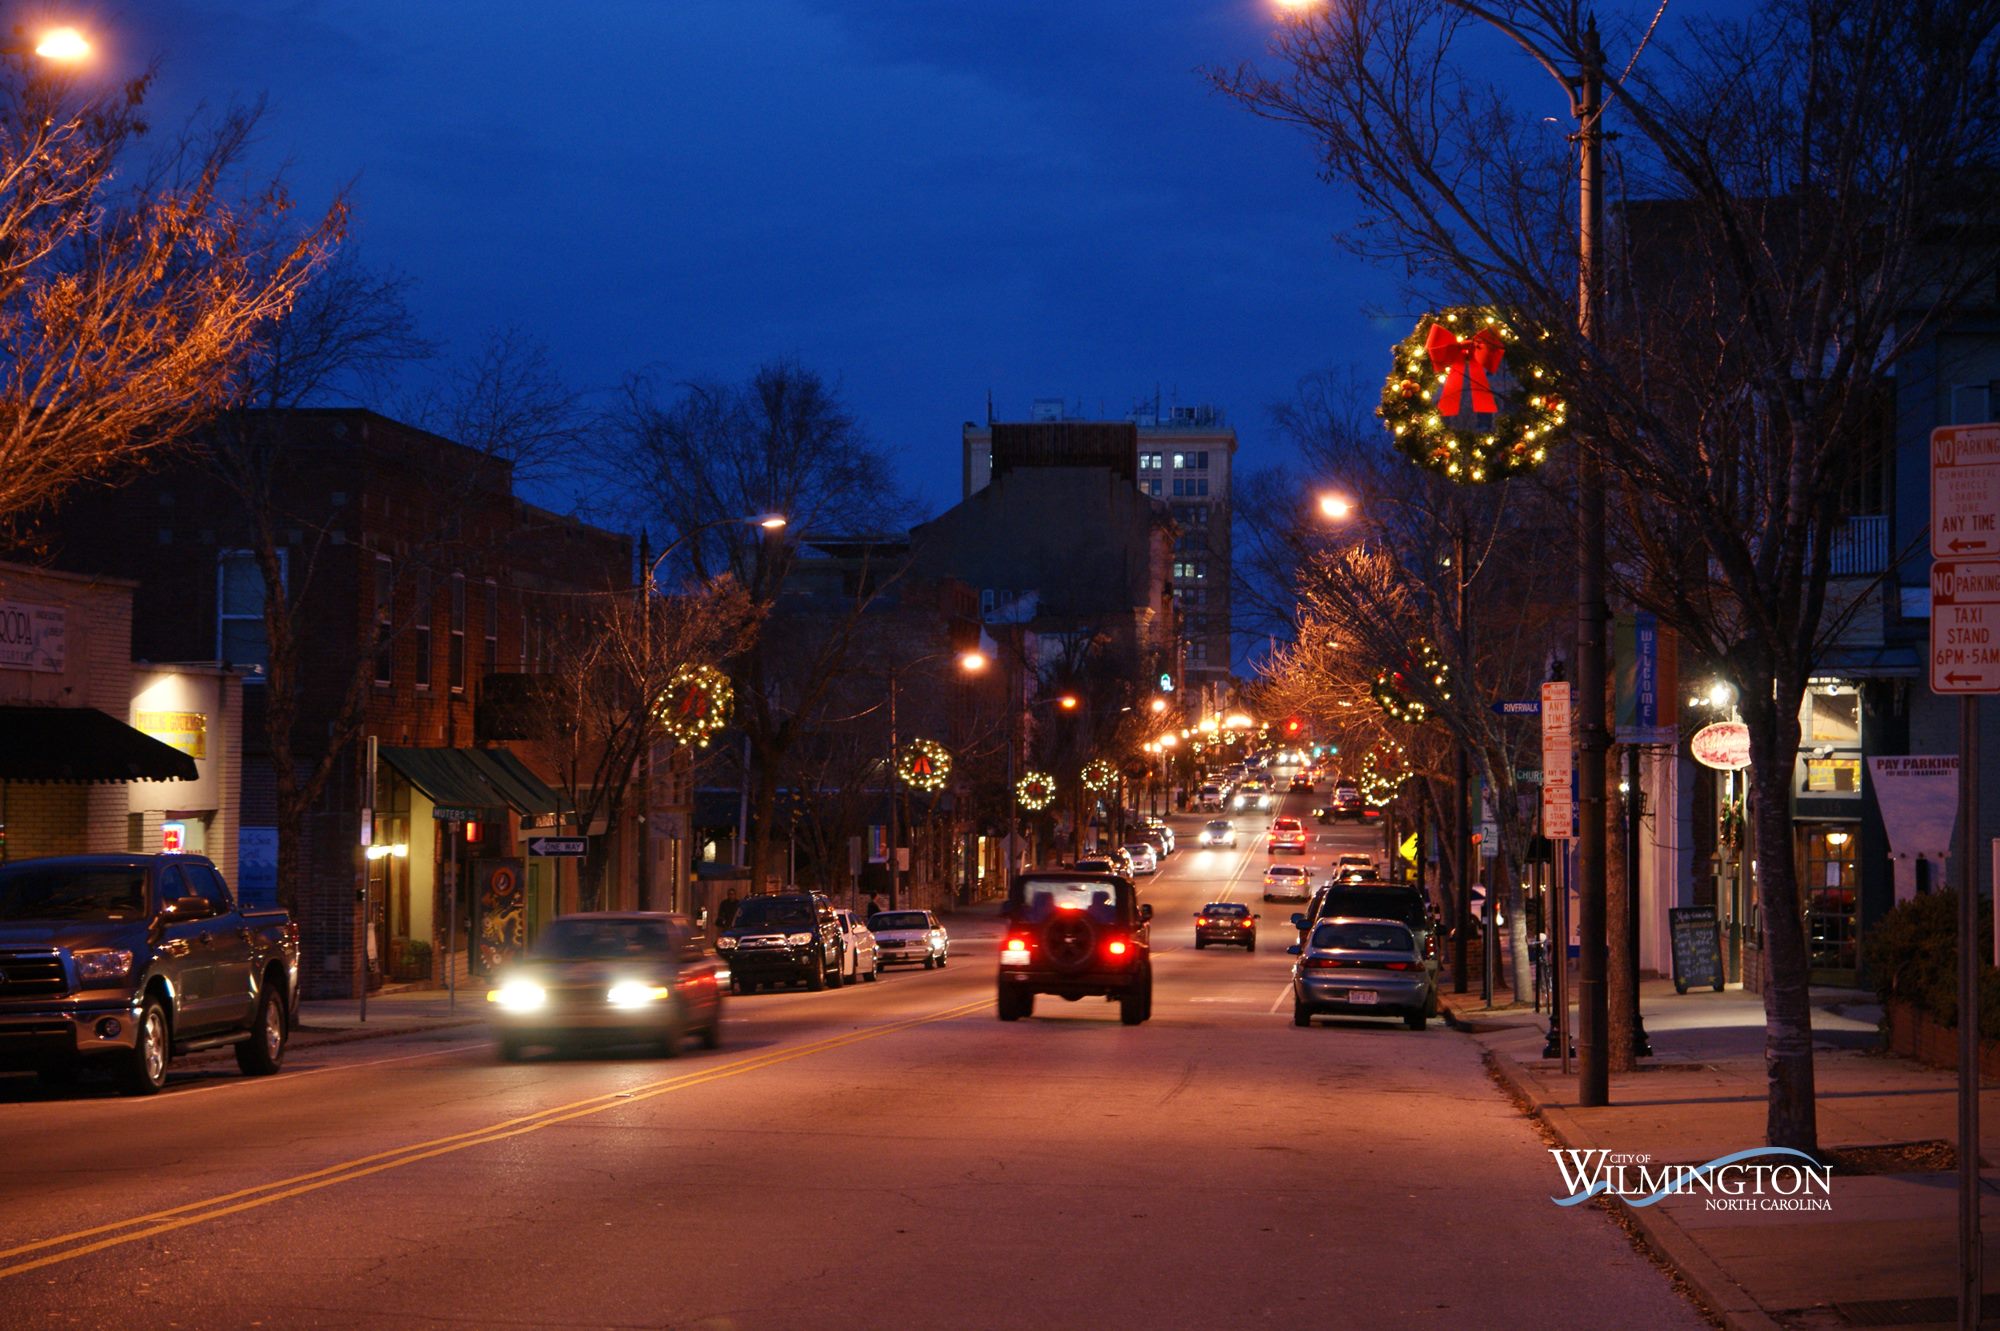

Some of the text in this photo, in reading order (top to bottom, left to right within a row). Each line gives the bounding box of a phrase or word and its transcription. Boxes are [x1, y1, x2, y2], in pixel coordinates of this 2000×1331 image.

[1935, 439, 1953, 465] NO
[1938, 469, 1997, 480] COMMERCIAL
[1948, 480, 1988, 491] VEHICLE
[1948, 491, 1988, 502] LOADING
[1955, 503, 1980, 513] ZONE
[1942, 513, 1996, 533] ANY TIME
[1934, 572, 1953, 597] NO
[1954, 607, 1982, 623] TAXI
[1947, 628, 1989, 644] STAND
[1640, 630, 1653, 717] WELCOME
[1503, 703, 1539, 713] RIVERWALK
[1548, 701, 1565, 712] ANY
[1548, 714, 1567, 724] TIME
[1877, 758, 1959, 770] PAY PARKING
[1483, 827, 1490, 843] 2
[545, 842, 581, 852] ONE WAY
